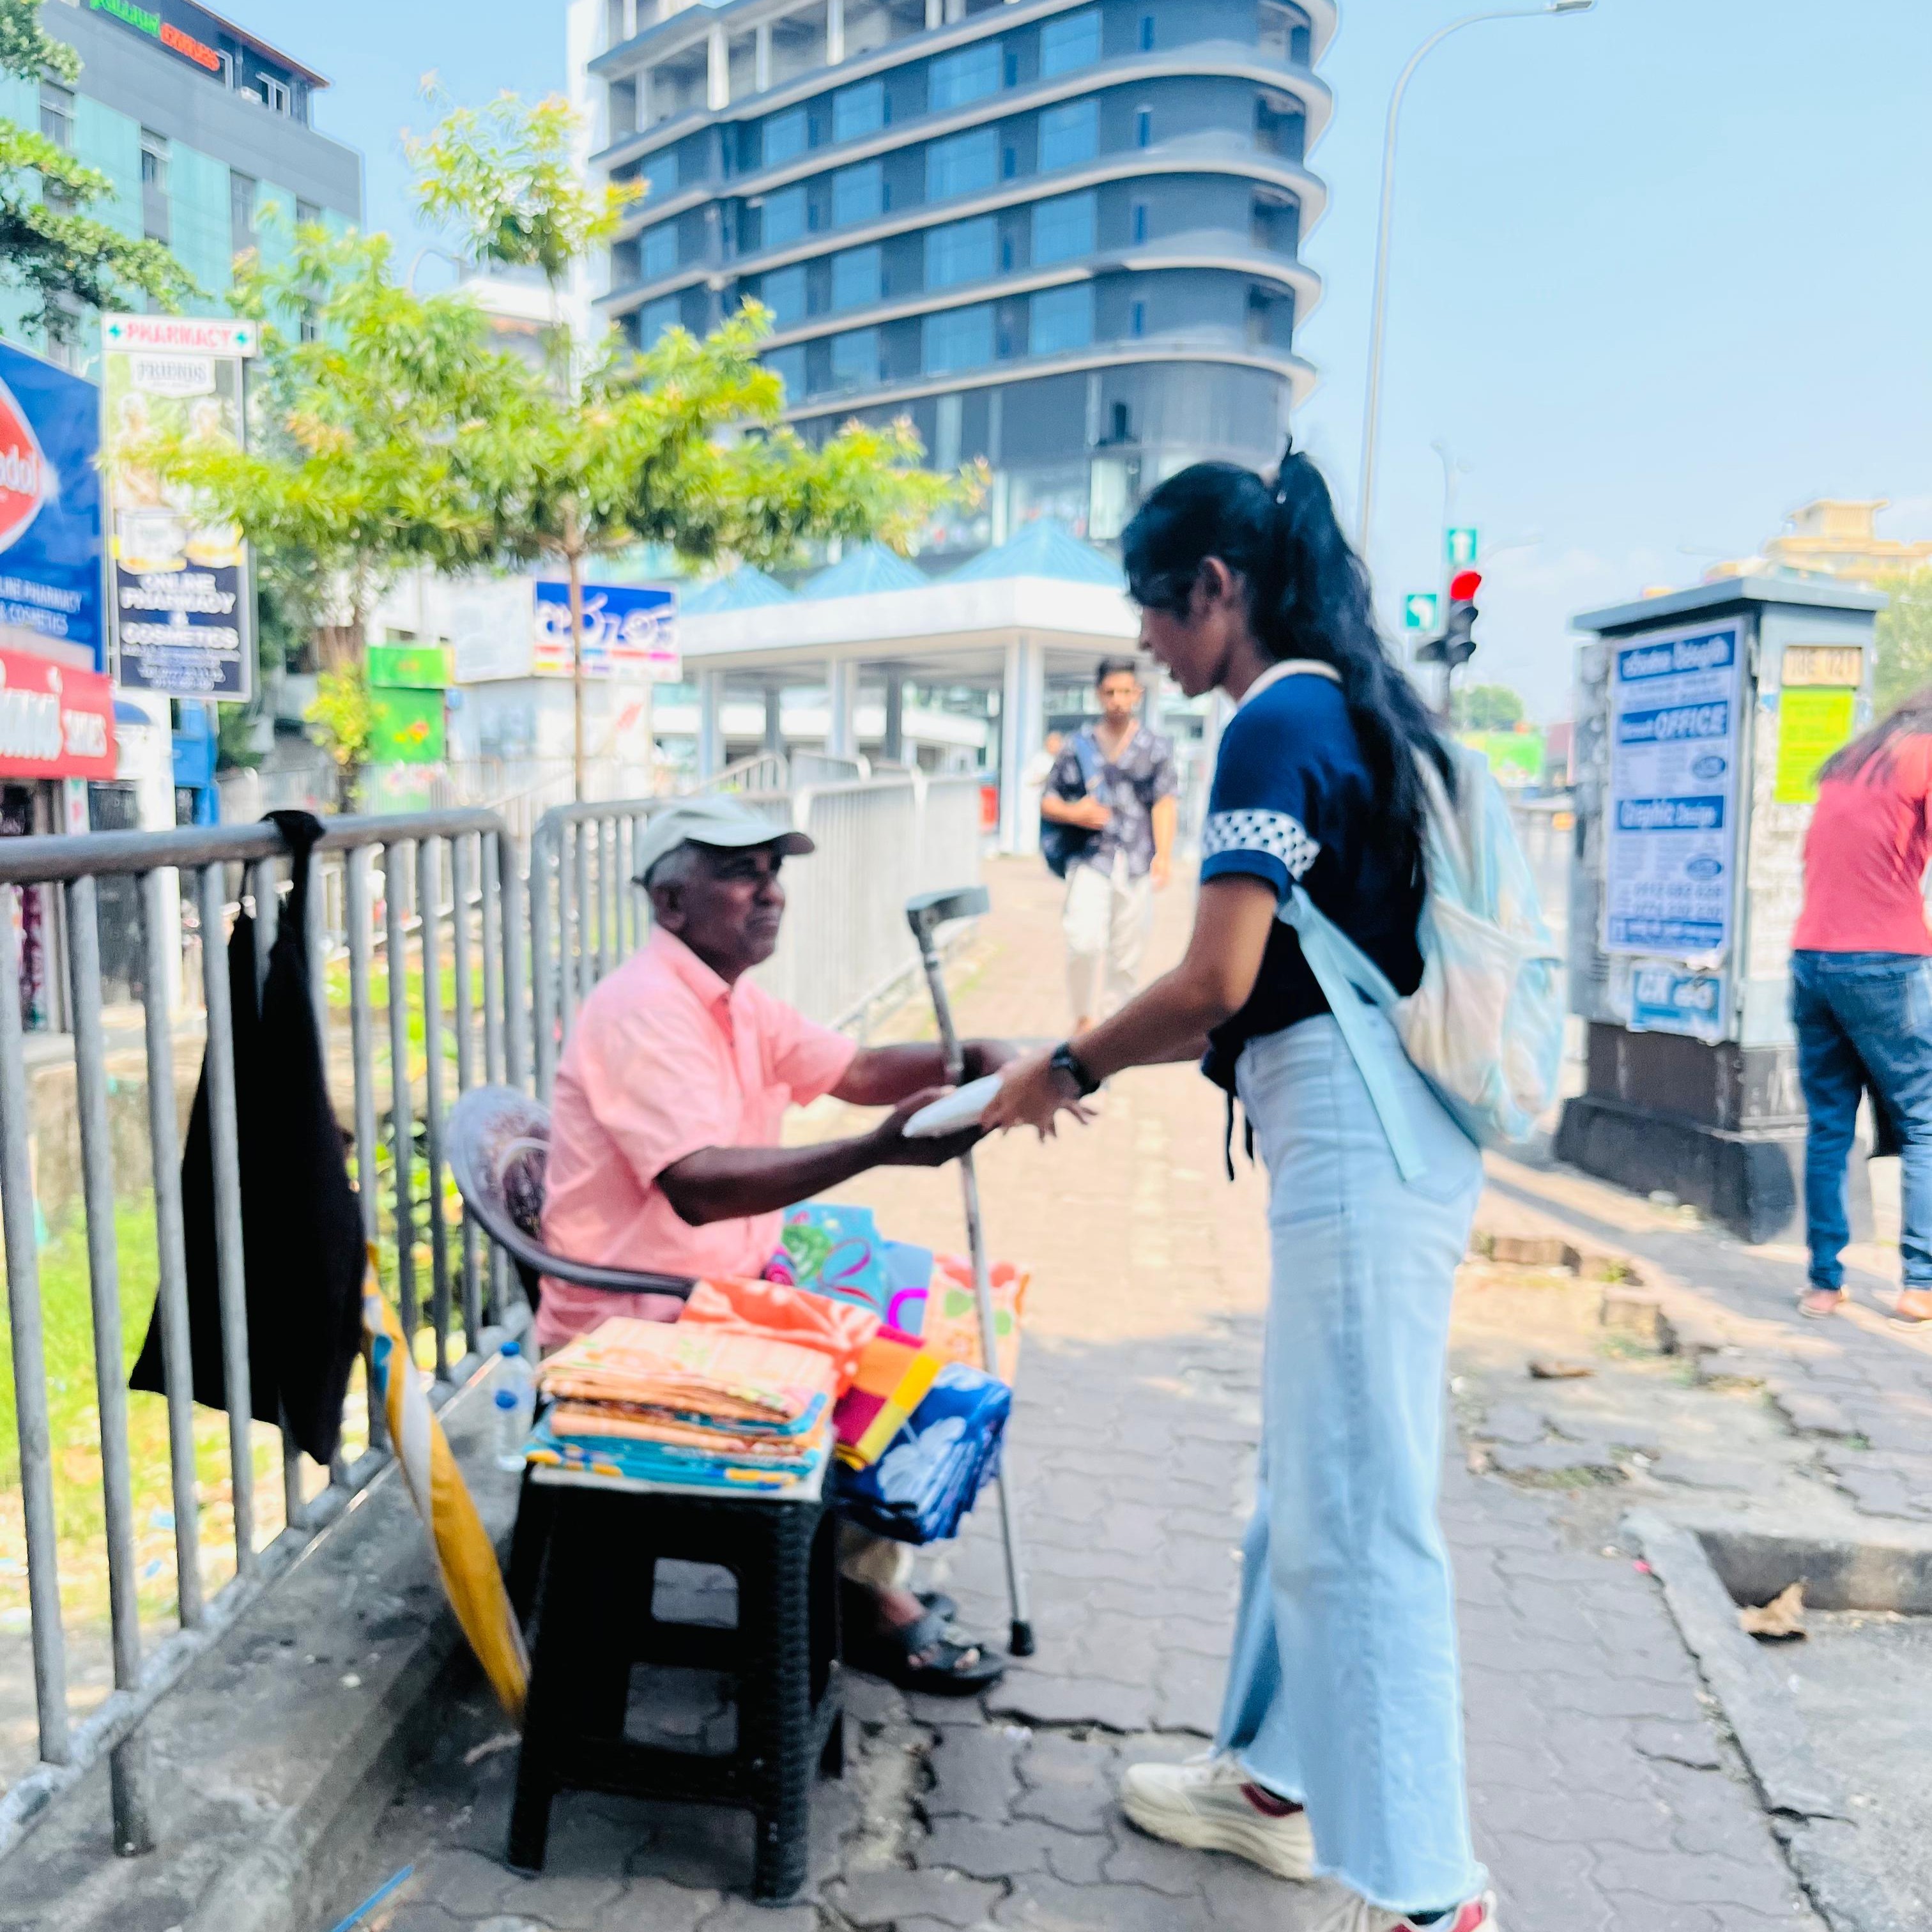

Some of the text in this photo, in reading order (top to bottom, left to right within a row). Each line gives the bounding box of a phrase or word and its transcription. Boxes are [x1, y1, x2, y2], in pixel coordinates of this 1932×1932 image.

[126, 323, 231, 348] PHARMACY
[136, 359, 208, 383] FRIENDS
[24, 580, 82, 613] PHARMACY
[142, 574, 216, 594] ONLINE
[119, 588, 236, 613] PHARMACY
[9, 602, 68, 636] COSMETICS
[121, 624, 239, 648] COSMETICS
[1655, 703, 1727, 740] OFFICE
[1621, 800, 1675, 828] Graphic
